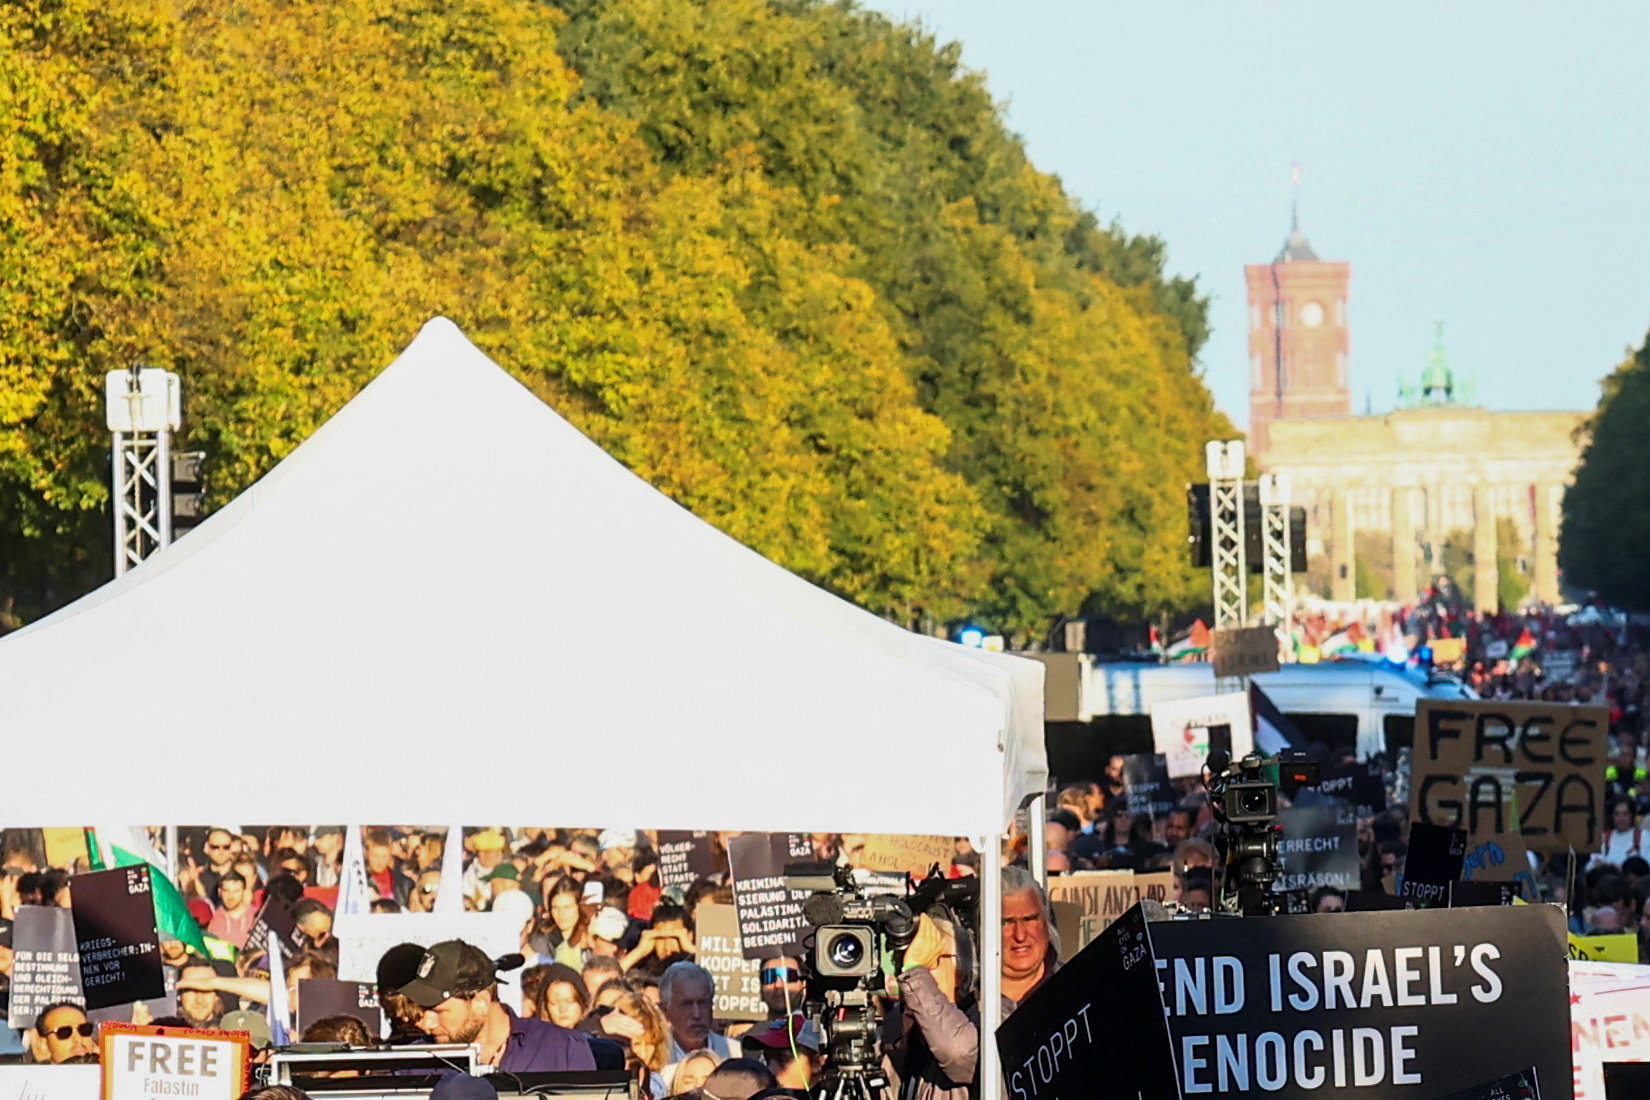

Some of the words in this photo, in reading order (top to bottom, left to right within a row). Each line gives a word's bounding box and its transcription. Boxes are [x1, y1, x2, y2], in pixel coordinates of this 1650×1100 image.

[1428, 709, 1597, 766] FREE
[1418, 771, 1596, 845] GAZA
[1276, 837, 1340, 853] ERRECHT
[736, 877, 784, 892] KRIMINA
[1402, 881, 1445, 902] STOPPT
[738, 890, 785, 906] SIERUNG
[742, 913, 810, 934] SOLIDARITÄ
[701, 936, 742, 951] MILI
[743, 932, 796, 948] BEENDEN!
[700, 957, 761, 973] KOOPER
[1122, 943, 1147, 971] GAZA
[83, 964, 99, 975] NEN
[104, 960, 120, 971] VOR
[741, 976, 761, 993] IS
[127, 1041, 218, 1077] FREE
[1182, 1025, 1422, 1094] ENOCIDE
[144, 1078, 199, 1096] Falastin
[1490, 1087, 1504, 1098] ALL
